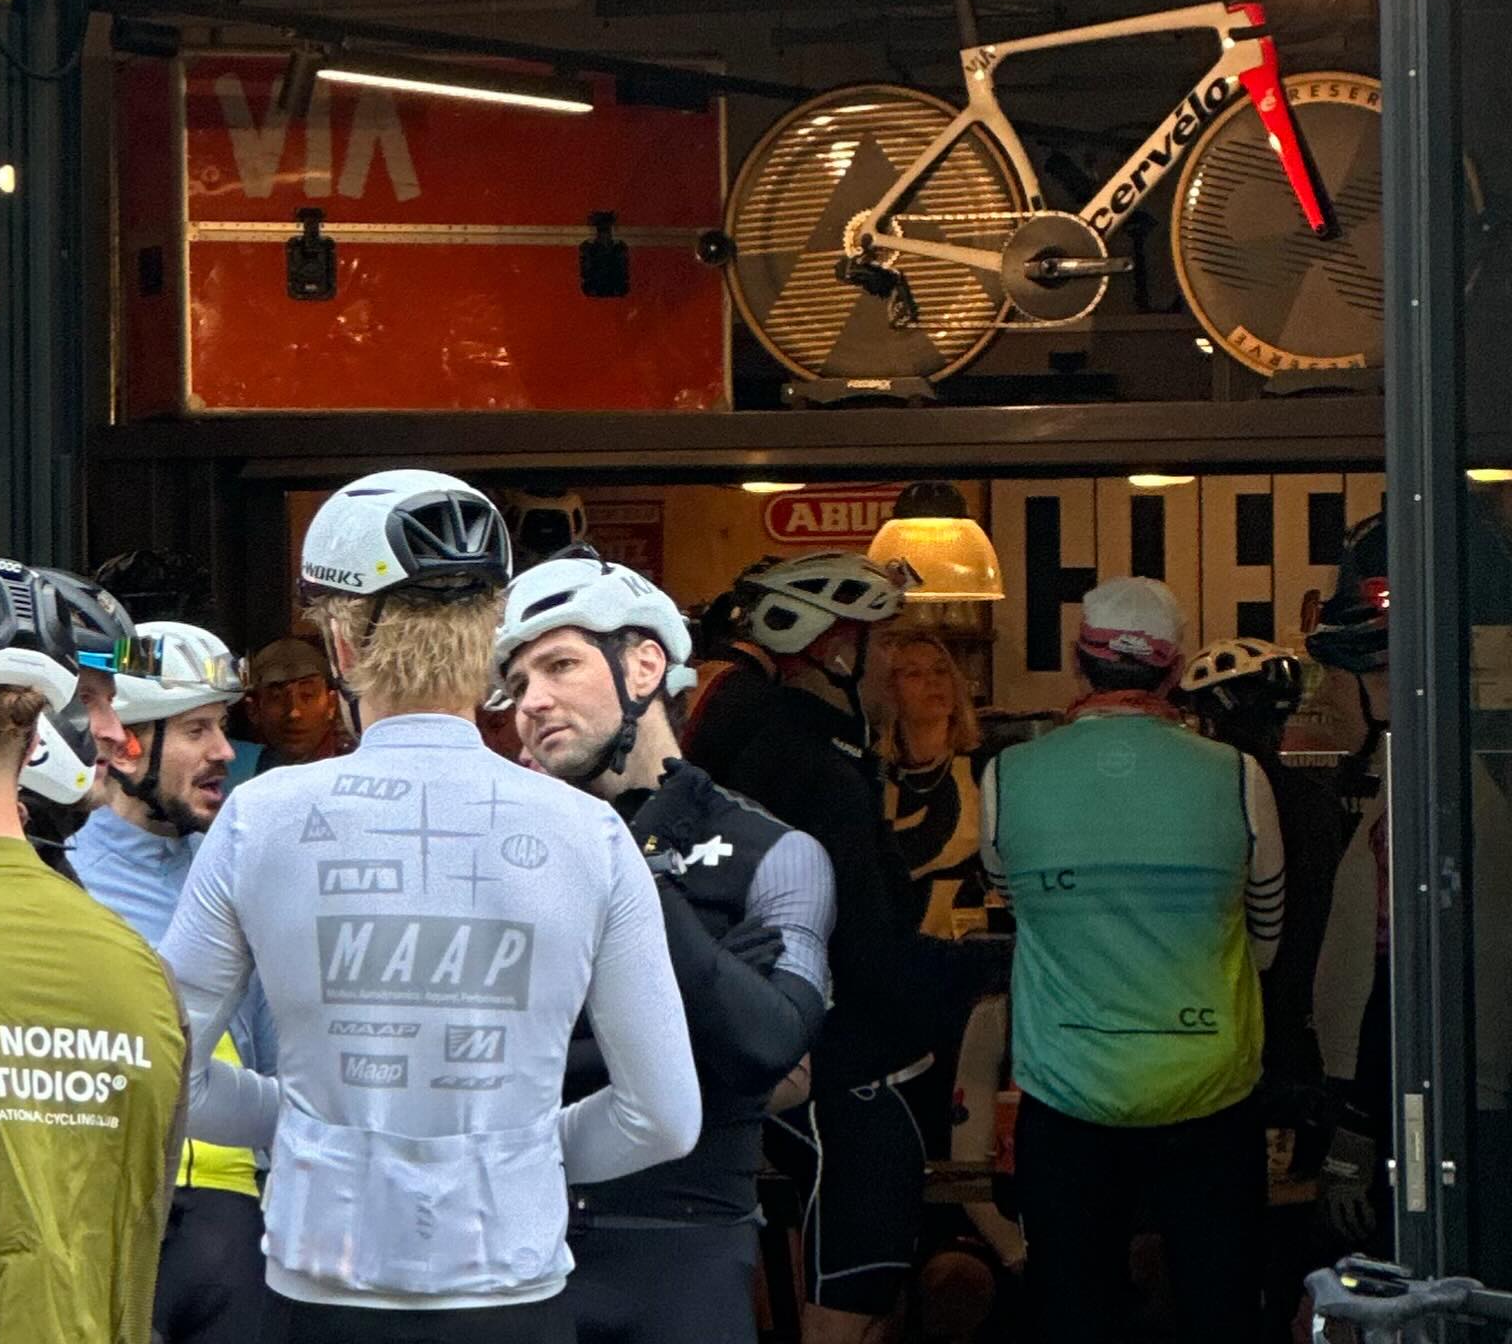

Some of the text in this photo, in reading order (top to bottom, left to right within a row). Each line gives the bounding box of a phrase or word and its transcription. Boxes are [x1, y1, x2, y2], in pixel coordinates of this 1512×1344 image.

[1040, 870, 1076, 891] LC
[326, 921, 528, 988] MAAP
[1179, 1008, 1218, 1027] CC
[0, 1025, 152, 1068] NORMAL
[345, 1058, 403, 1083] Maap
